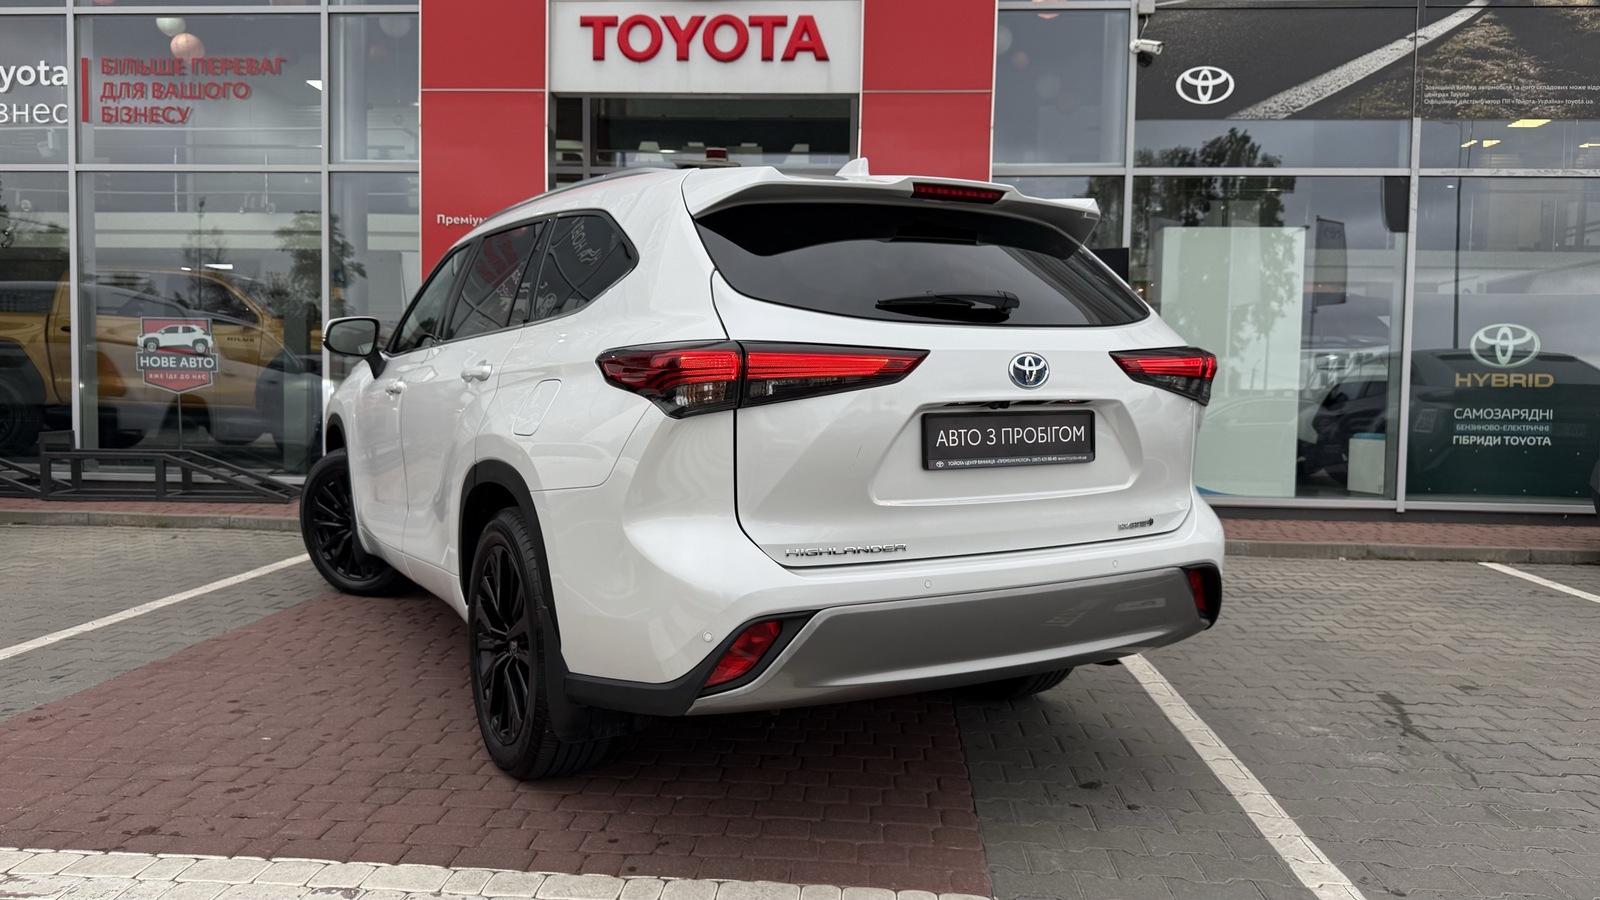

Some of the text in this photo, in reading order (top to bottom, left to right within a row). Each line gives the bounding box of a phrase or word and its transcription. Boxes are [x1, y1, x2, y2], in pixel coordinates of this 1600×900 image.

[579, 14, 830, 63] TOYOTA
[101, 57, 287, 75] БІЛЬШЕ ПЕРЕВАГ
[100, 82, 251, 102] ДЛЯ ВАШОГО
[101, 106, 191, 123] БІЗНЕСУ
[140, 356, 215, 369] НОВЕ АВТО
[1455, 373, 1554, 388] HYBRID
[1453, 408, 1554, 421] САМОЗАРЯДНІ
[1456, 424, 1550, 432] БЕНЗИНОВО-ЕЛЕКТРИЧНІ
[935, 425, 1085, 447] АВТО З ПРОБІГОМ
[1452, 435, 1552, 447] ГІБРИДИ TOYOTA
[785, 543, 907, 558] HIGHLANDER
